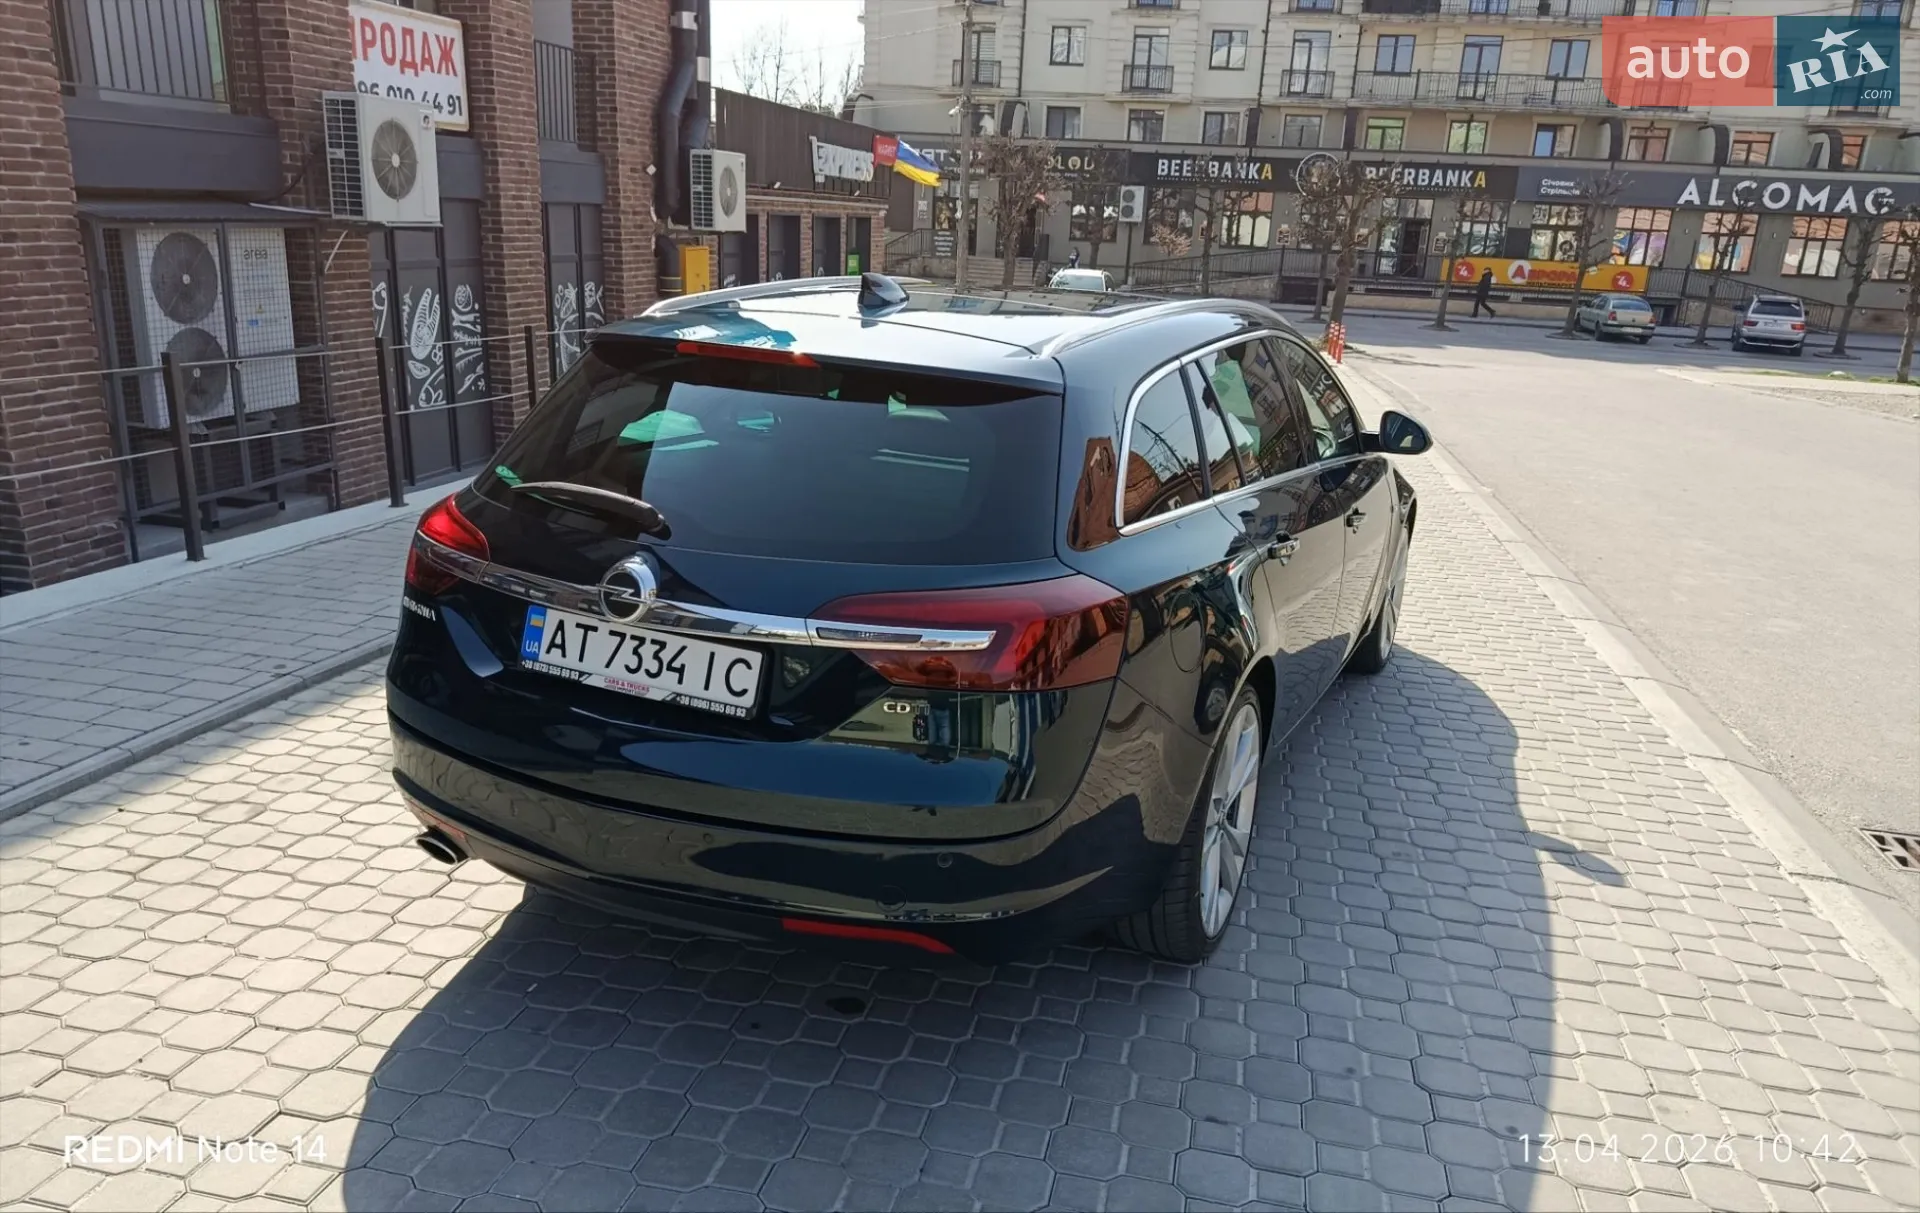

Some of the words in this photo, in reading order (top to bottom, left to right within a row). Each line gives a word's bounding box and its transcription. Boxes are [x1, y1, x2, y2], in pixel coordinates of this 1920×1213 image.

[447, 94, 462, 116] 91
[809, 136, 874, 182] EXPRESS
[1677, 178, 1895, 215] ALCOMAG
[525, 640, 539, 654] UA
[545, 618, 599, 663] AT
[604, 629, 688, 686] 7334
[703, 651, 753, 698] IC
[710, 702, 725, 713] 555
